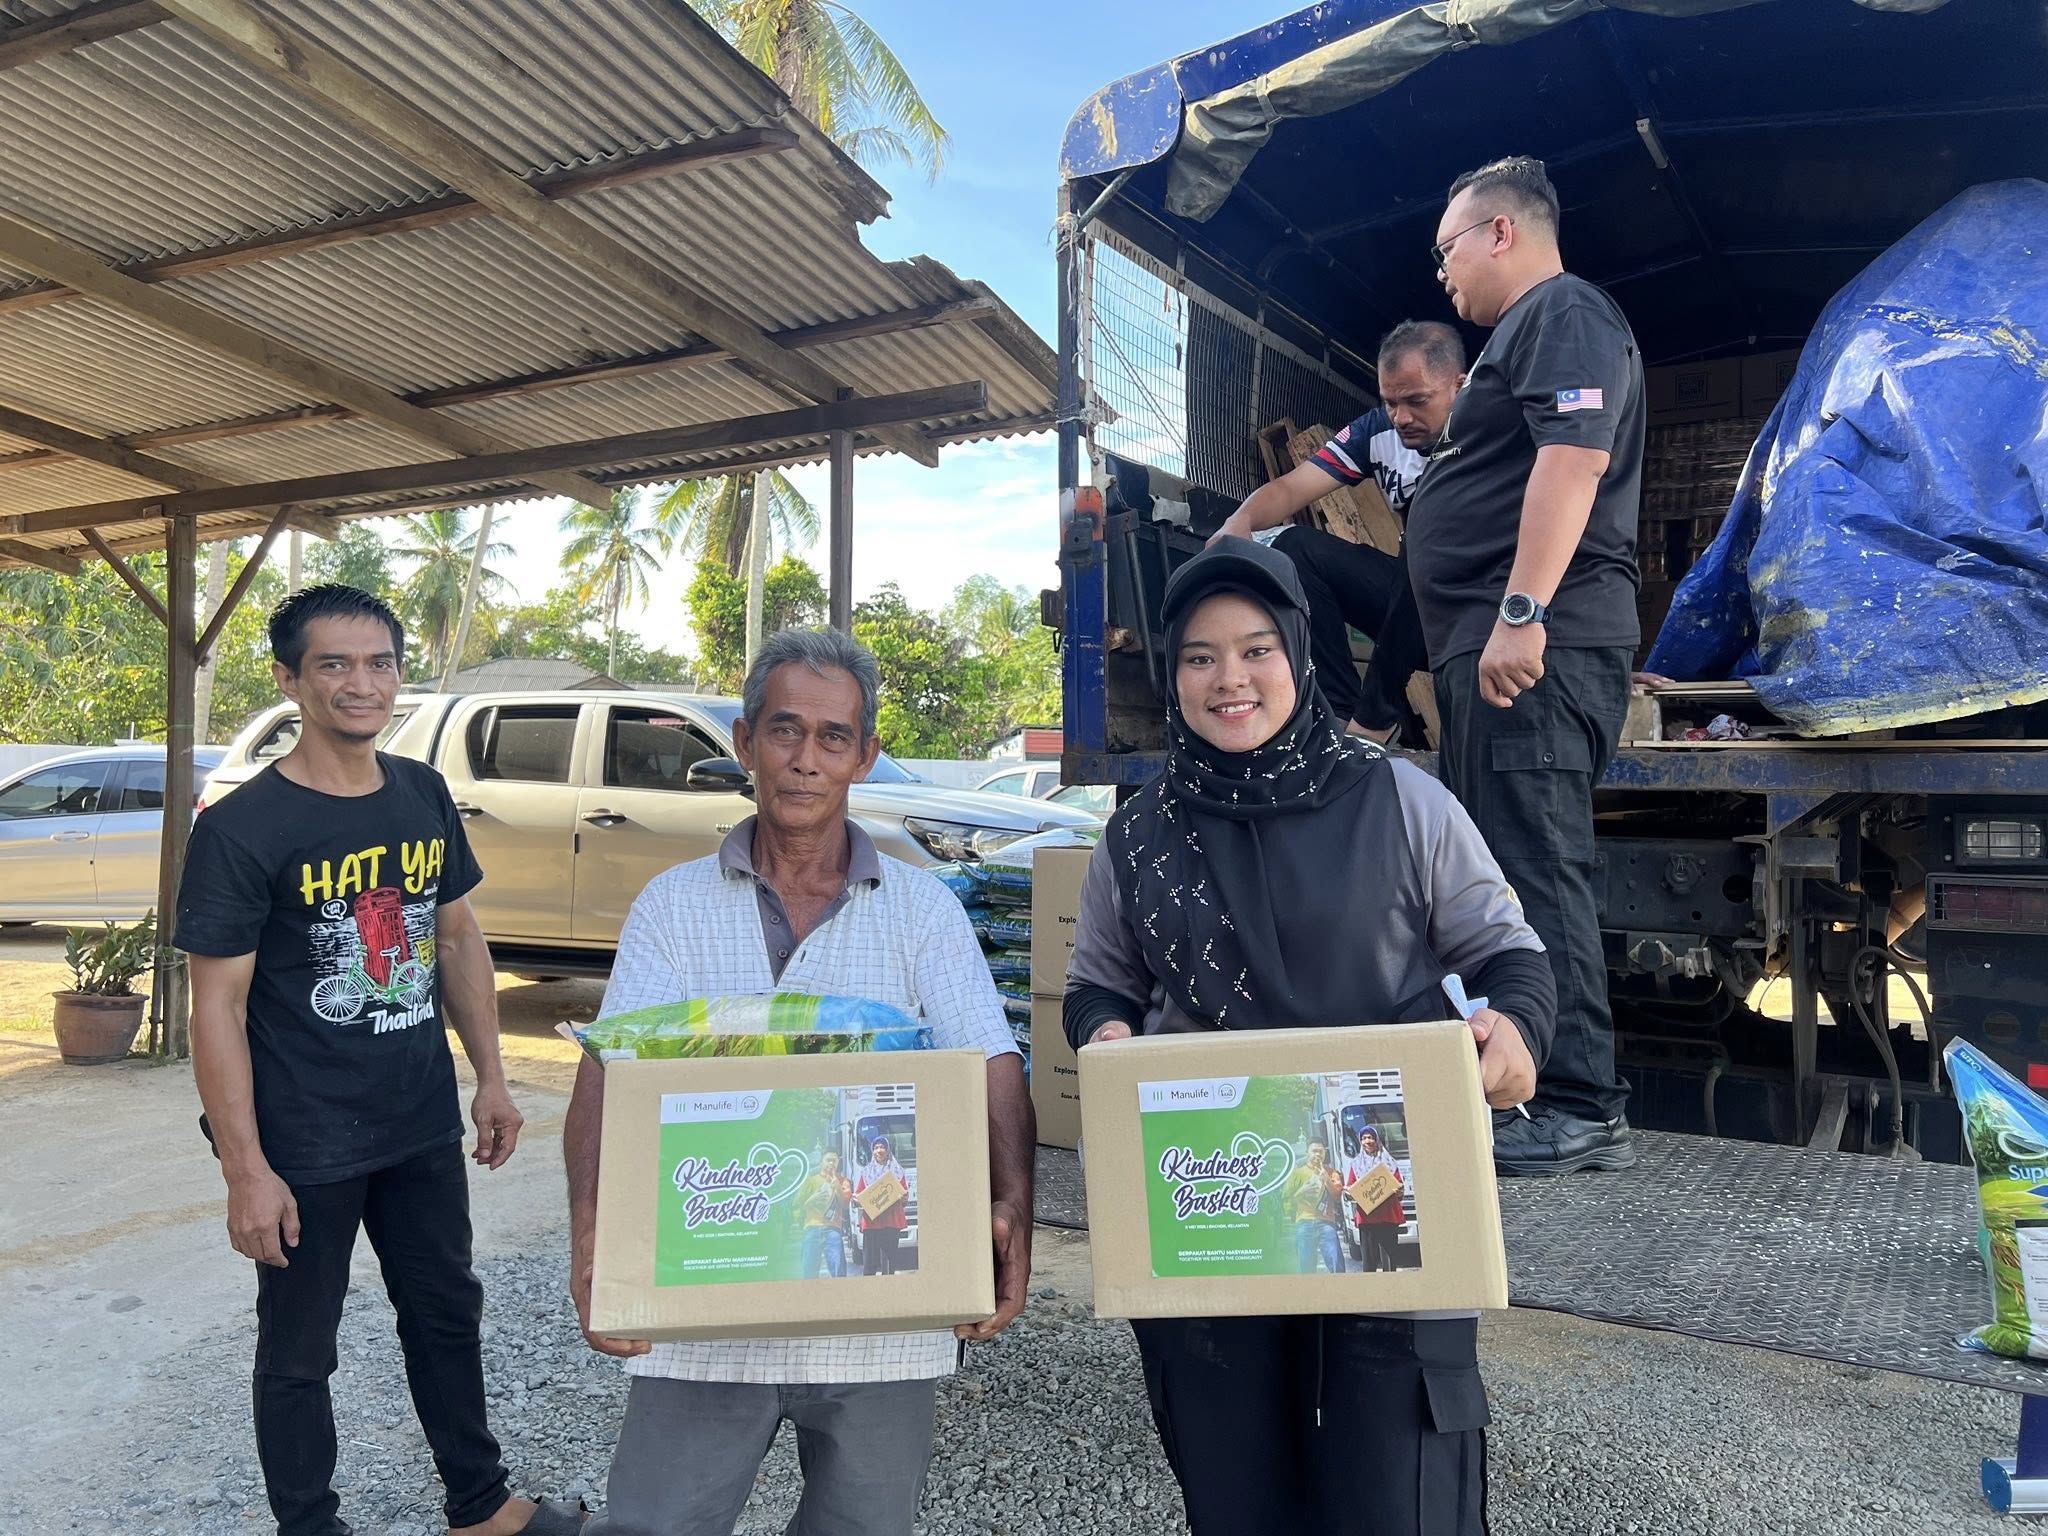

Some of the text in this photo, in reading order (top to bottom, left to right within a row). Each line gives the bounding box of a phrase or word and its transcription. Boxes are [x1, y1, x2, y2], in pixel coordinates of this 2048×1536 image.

[300, 846, 387, 905] HAT
[693, 1100, 732, 1111] Manulife
[1171, 1088, 1209, 1100] Manulife
[674, 1158, 780, 1193] Kindness
[1160, 1147, 1264, 1184] Kindness
[684, 1192, 768, 1228] Basket
[1174, 1184, 1256, 1219] Basket
